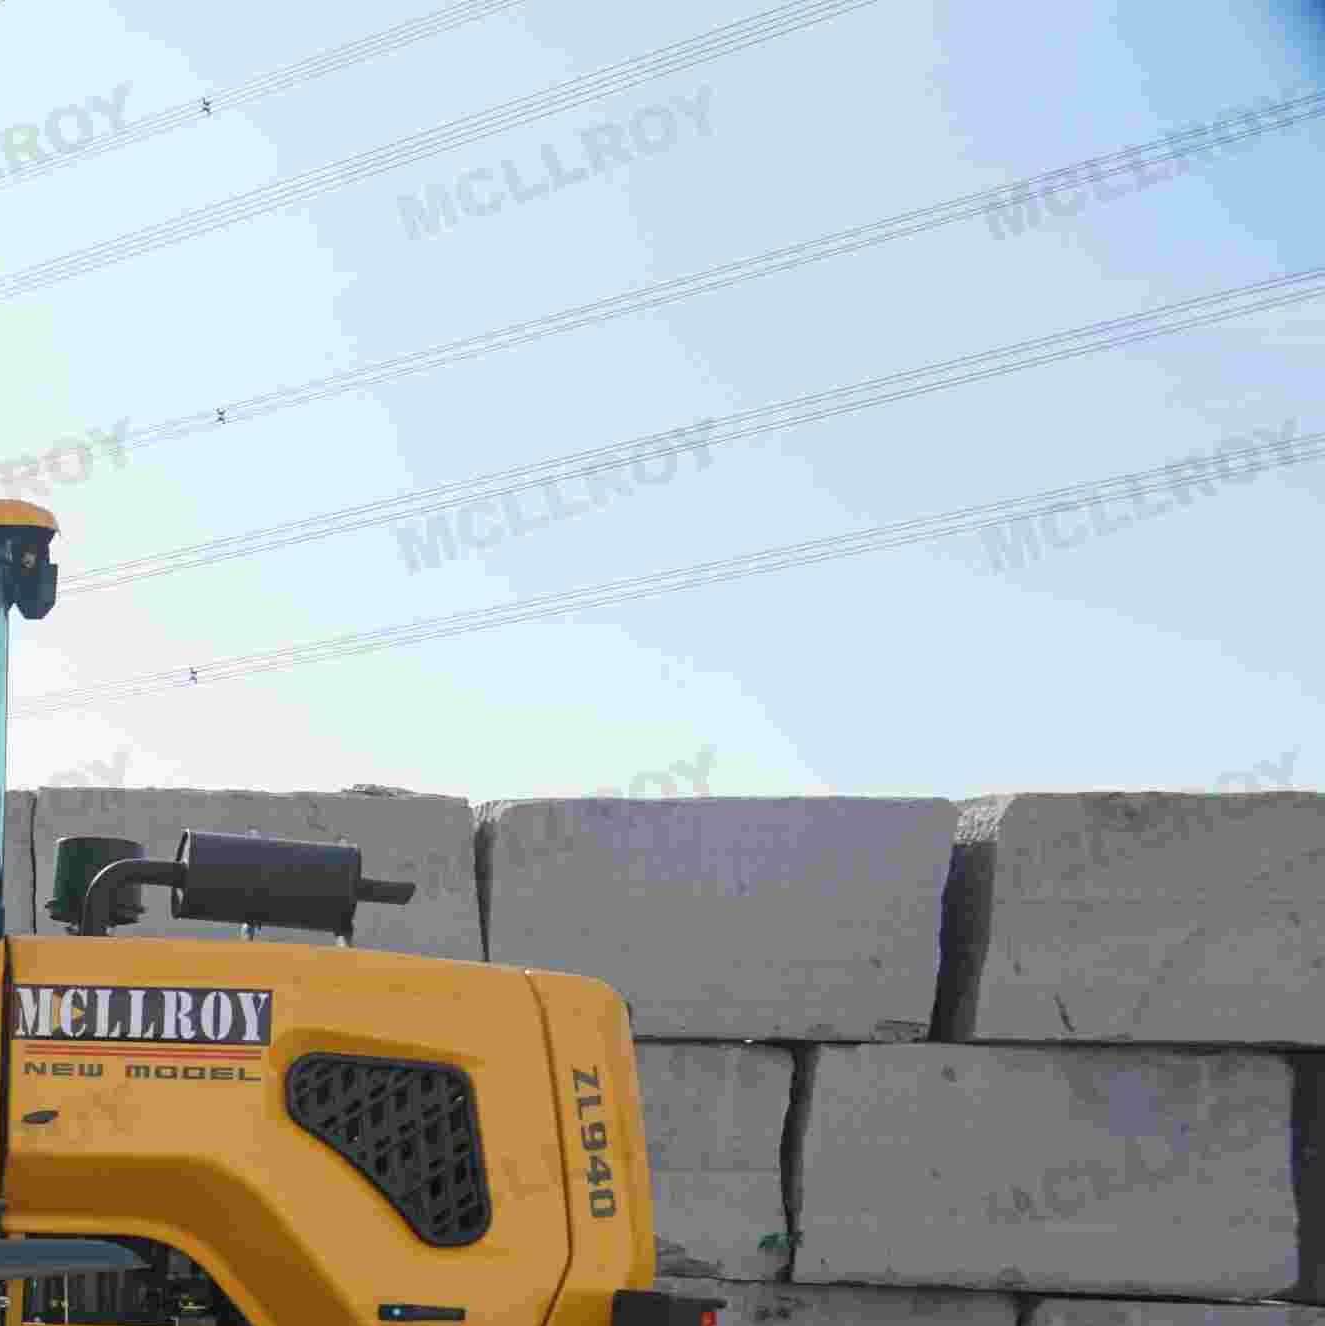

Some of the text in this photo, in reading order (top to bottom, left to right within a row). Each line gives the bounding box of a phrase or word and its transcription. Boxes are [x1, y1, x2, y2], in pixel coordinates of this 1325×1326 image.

[14, 985, 270, 1043] MCLLROY
[22, 1061, 263, 1082] NEW MODEL
[571, 1062, 617, 1218] ZL940
